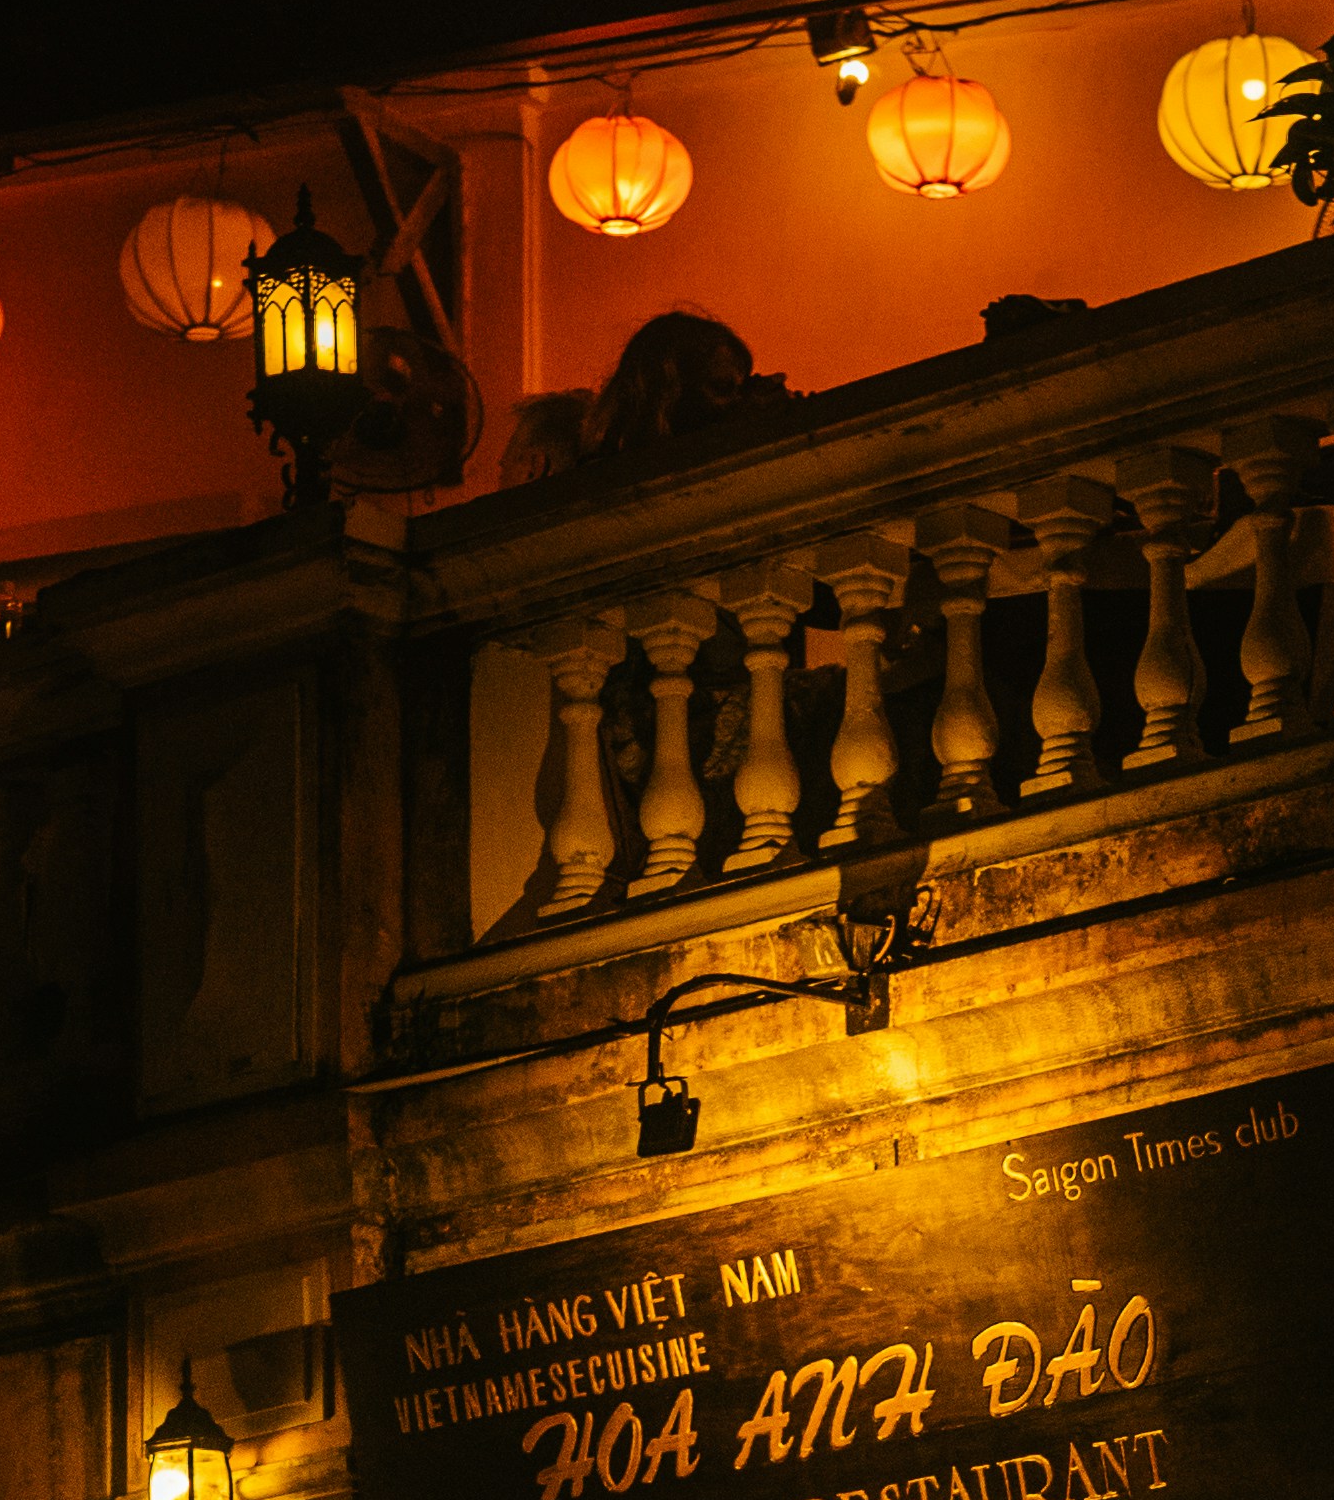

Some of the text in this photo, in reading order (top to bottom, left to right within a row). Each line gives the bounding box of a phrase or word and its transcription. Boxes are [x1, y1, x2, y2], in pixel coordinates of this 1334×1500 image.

[1002, 1101, 1299, 1201] Saigon Times club
[498, 1296, 598, 1354] HÀNG
[604, 1271, 687, 1329] VIỆT
[720, 1249, 801, 1307] NAM
[733, 1343, 935, 1468] ANH
